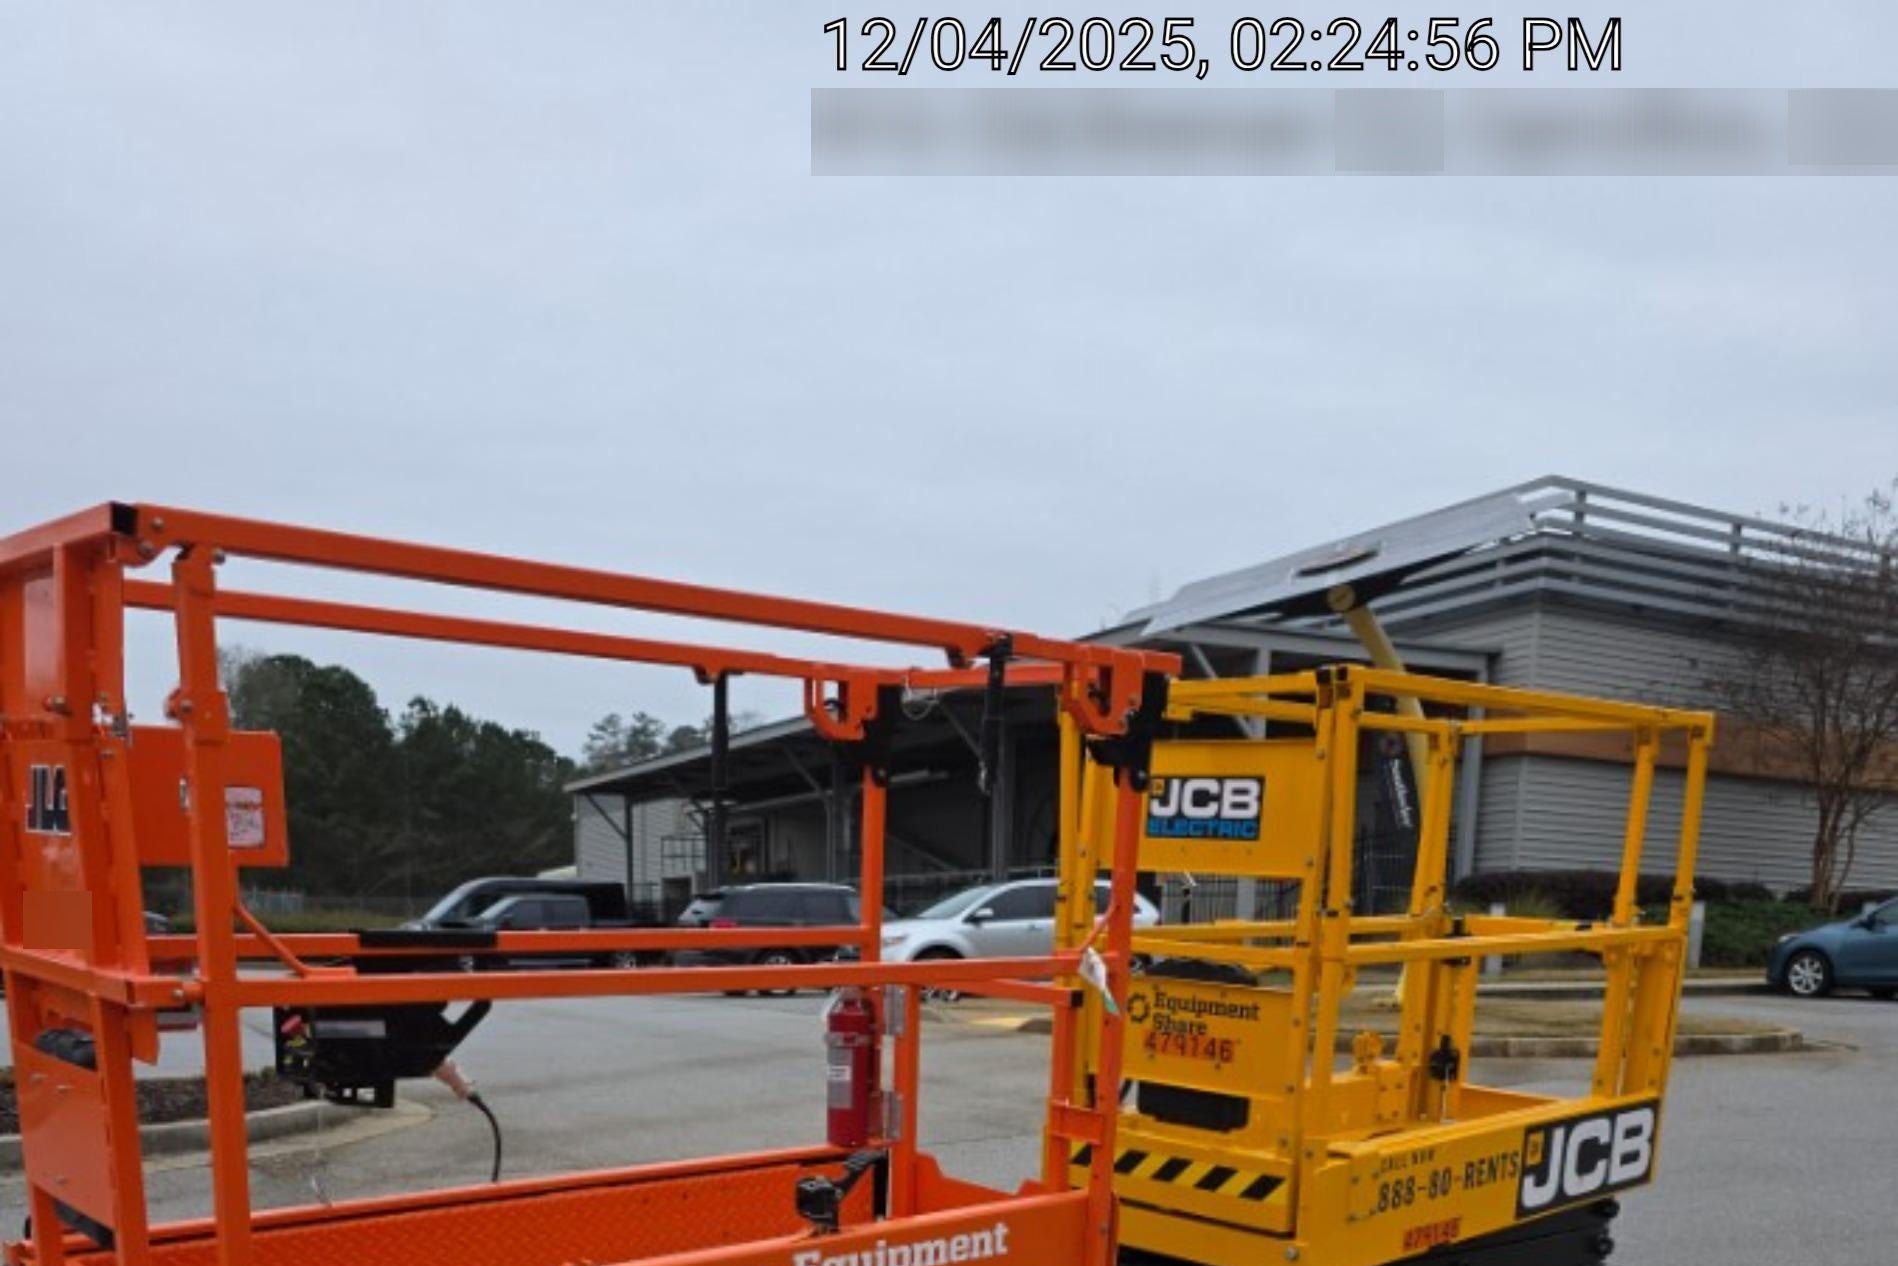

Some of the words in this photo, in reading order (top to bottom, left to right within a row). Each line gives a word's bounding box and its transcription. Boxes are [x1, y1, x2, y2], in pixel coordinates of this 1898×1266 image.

[1150, 778, 1261, 819] JCB
[1148, 819, 1258, 838] ELECTRIC
[1153, 991, 1260, 1022] Equipment
[1152, 1012, 1208, 1036] Share
[1144, 1031, 1235, 1064] 479146
[1521, 1107, 1655, 1209] JCB
[1377, 1150, 1520, 1213] 888-80-RENTS
